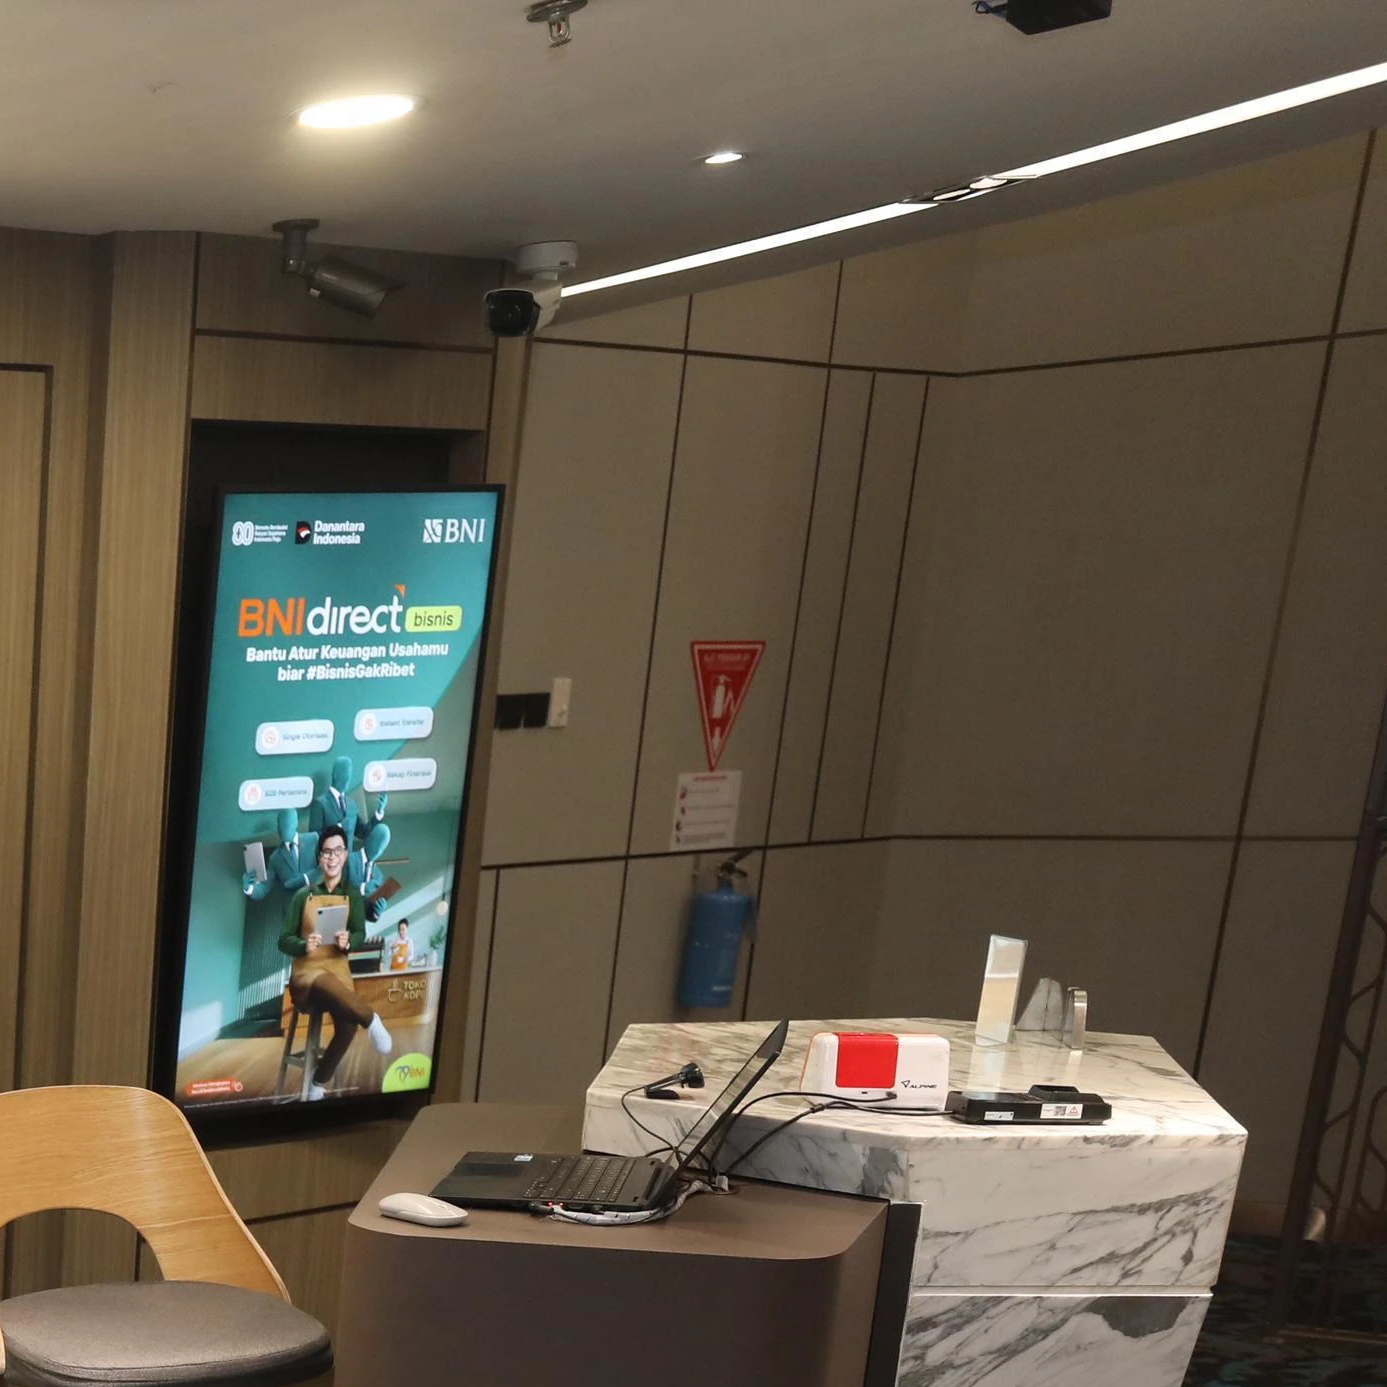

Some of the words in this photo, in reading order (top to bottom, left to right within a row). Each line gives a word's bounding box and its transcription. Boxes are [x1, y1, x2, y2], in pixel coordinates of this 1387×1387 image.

[314, 520, 365, 533] Danantara
[444, 518, 485, 543] BNI
[313, 533, 360, 545] Indonesia
[238, 597, 305, 637] BNI
[306, 595, 403, 636] direct
[413, 610, 454, 628] bisnis
[246, 648, 286, 662] Bantu
[288, 645, 318, 660] Atur
[320, 643, 386, 660] Keuangan
[389, 642, 448, 656] Usahamu
[277, 667, 304, 681] biar
[306, 662, 415, 680] #BisnisGakRibet
[403, 979, 427, 991] TOKO
